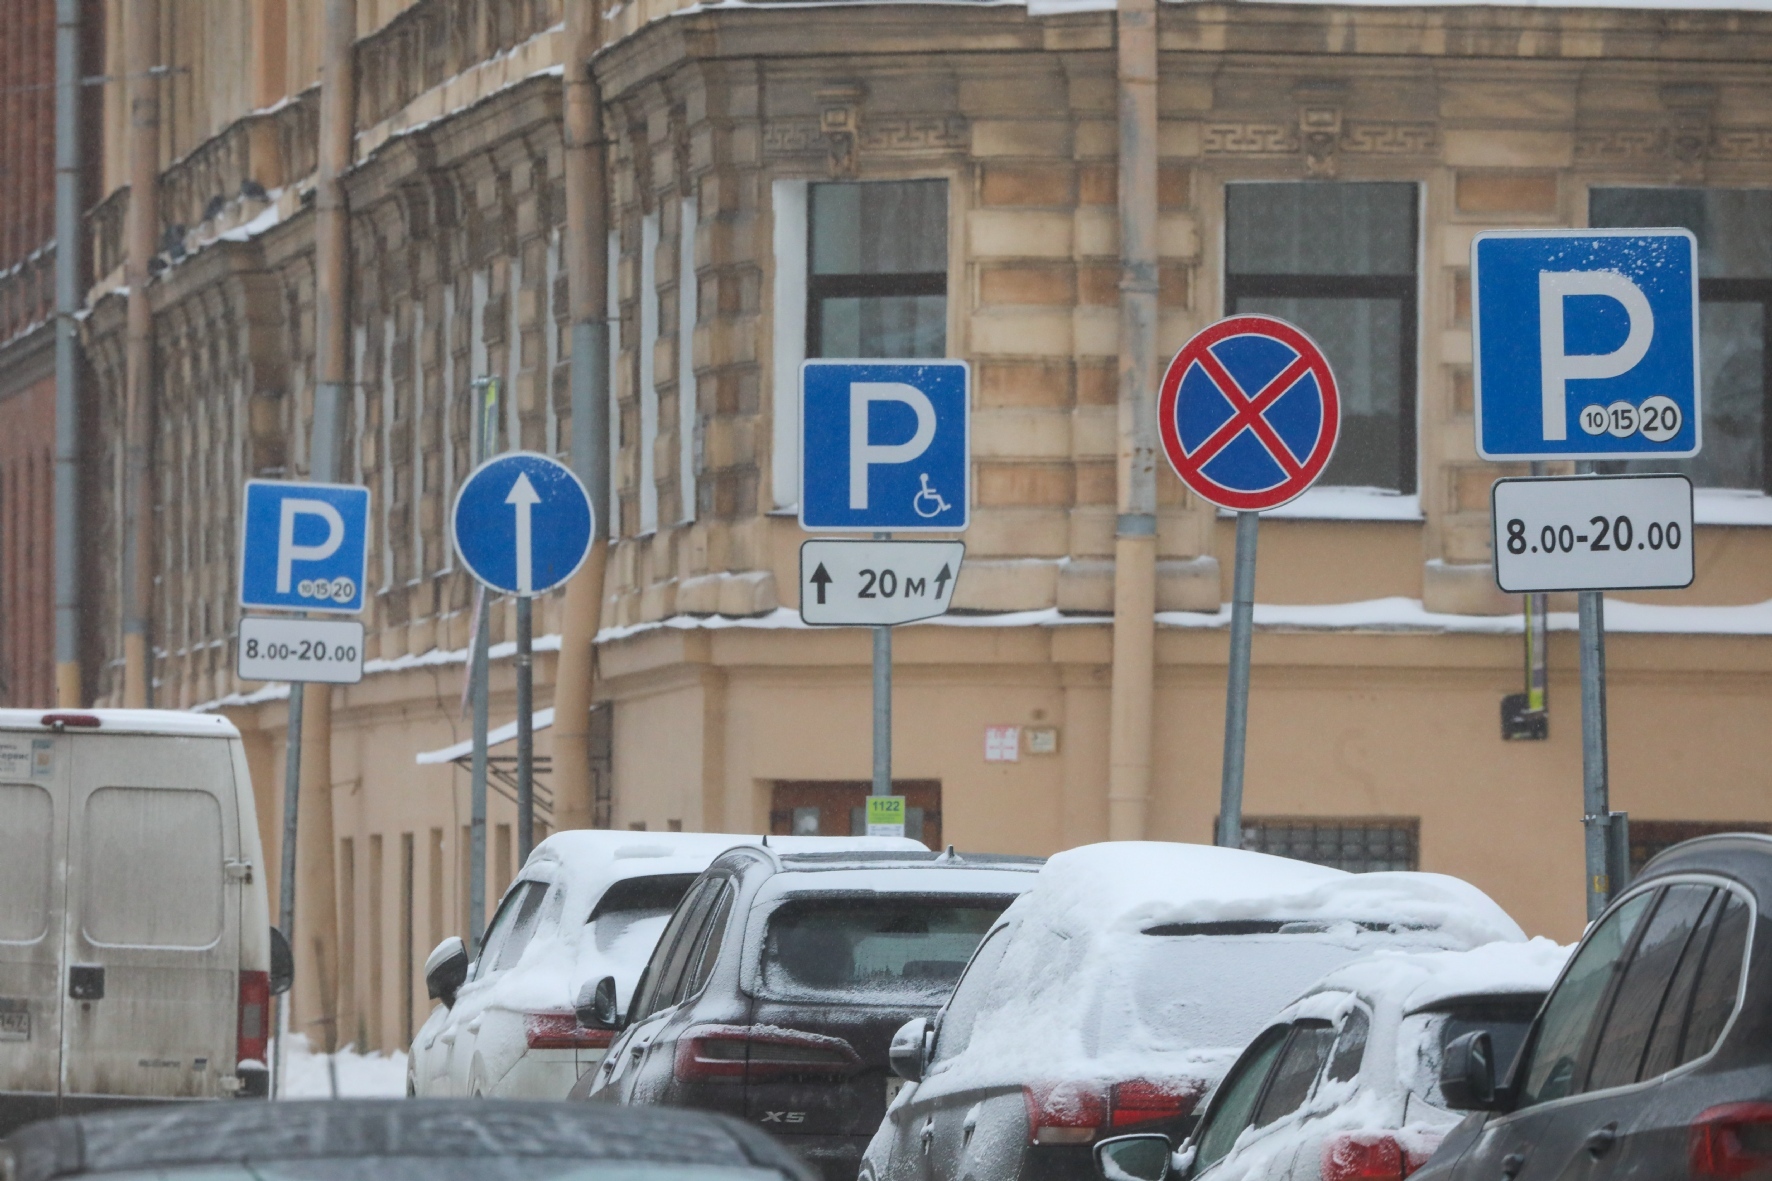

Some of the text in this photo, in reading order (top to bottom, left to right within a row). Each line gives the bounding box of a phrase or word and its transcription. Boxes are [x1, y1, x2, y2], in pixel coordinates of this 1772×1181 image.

[1538, 270, 1655, 441] P
[1585, 405, 1678, 433] 10 15 20
[849, 381, 937, 510] P
[276, 497, 345, 594] P
[1506, 514, 1682, 555] 8.00-20.00
[301, 581, 353, 598] 10 15 20
[857, 568, 898, 599] 20
[245, 638, 357, 663] 8.00-20.00
[872, 800, 900, 812] 1122
[761, 1111, 806, 1123] X5
